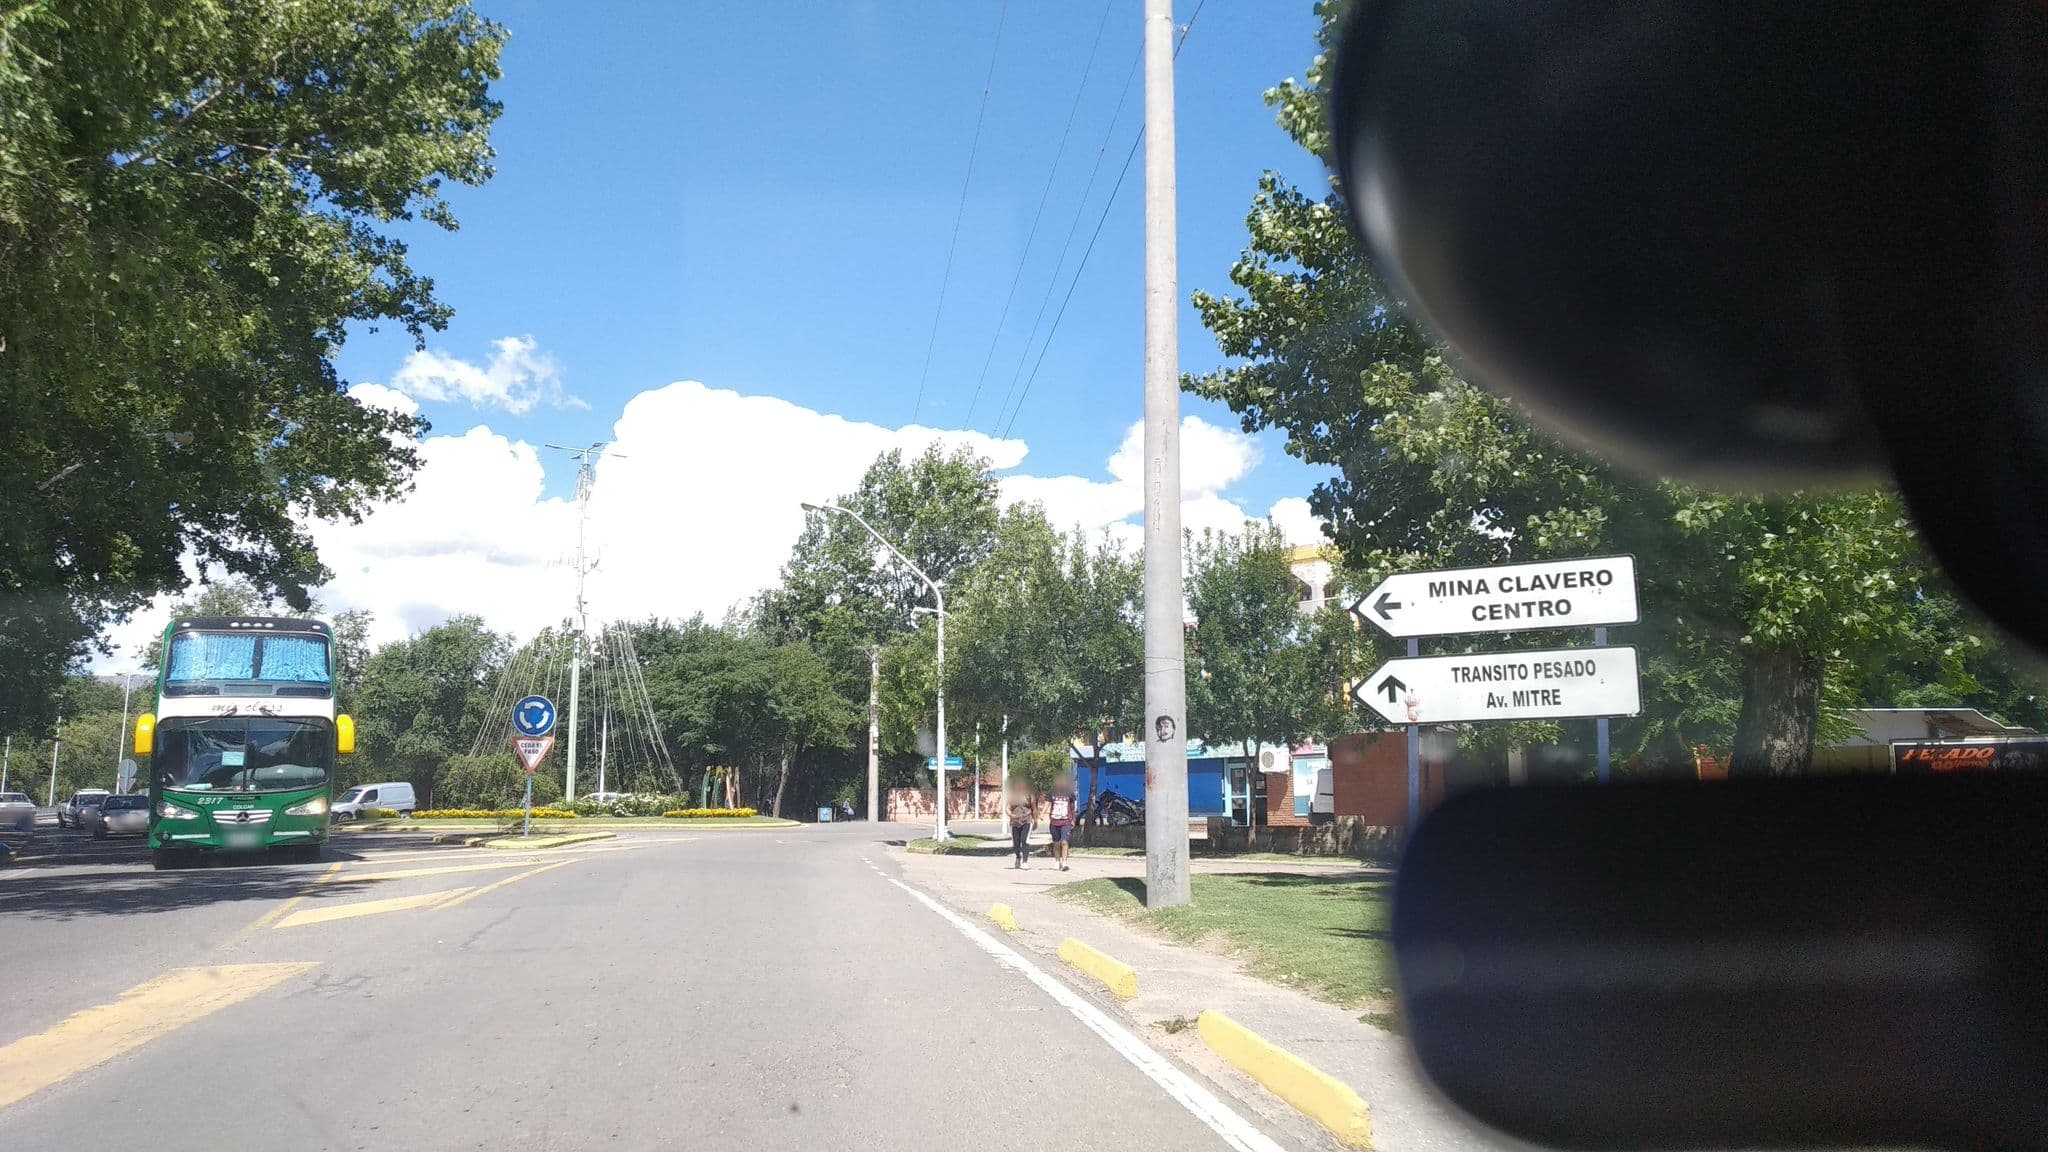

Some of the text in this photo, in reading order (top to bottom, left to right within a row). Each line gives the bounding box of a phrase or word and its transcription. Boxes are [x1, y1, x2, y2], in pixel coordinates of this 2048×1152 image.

[1429, 569, 1613, 598] MINA CLAVERO
[1472, 599, 1572, 621] CENTRO
[1451, 660, 1596, 683] TRANSITO PESADO
[1486, 689, 1562, 708] Av. MITRE
